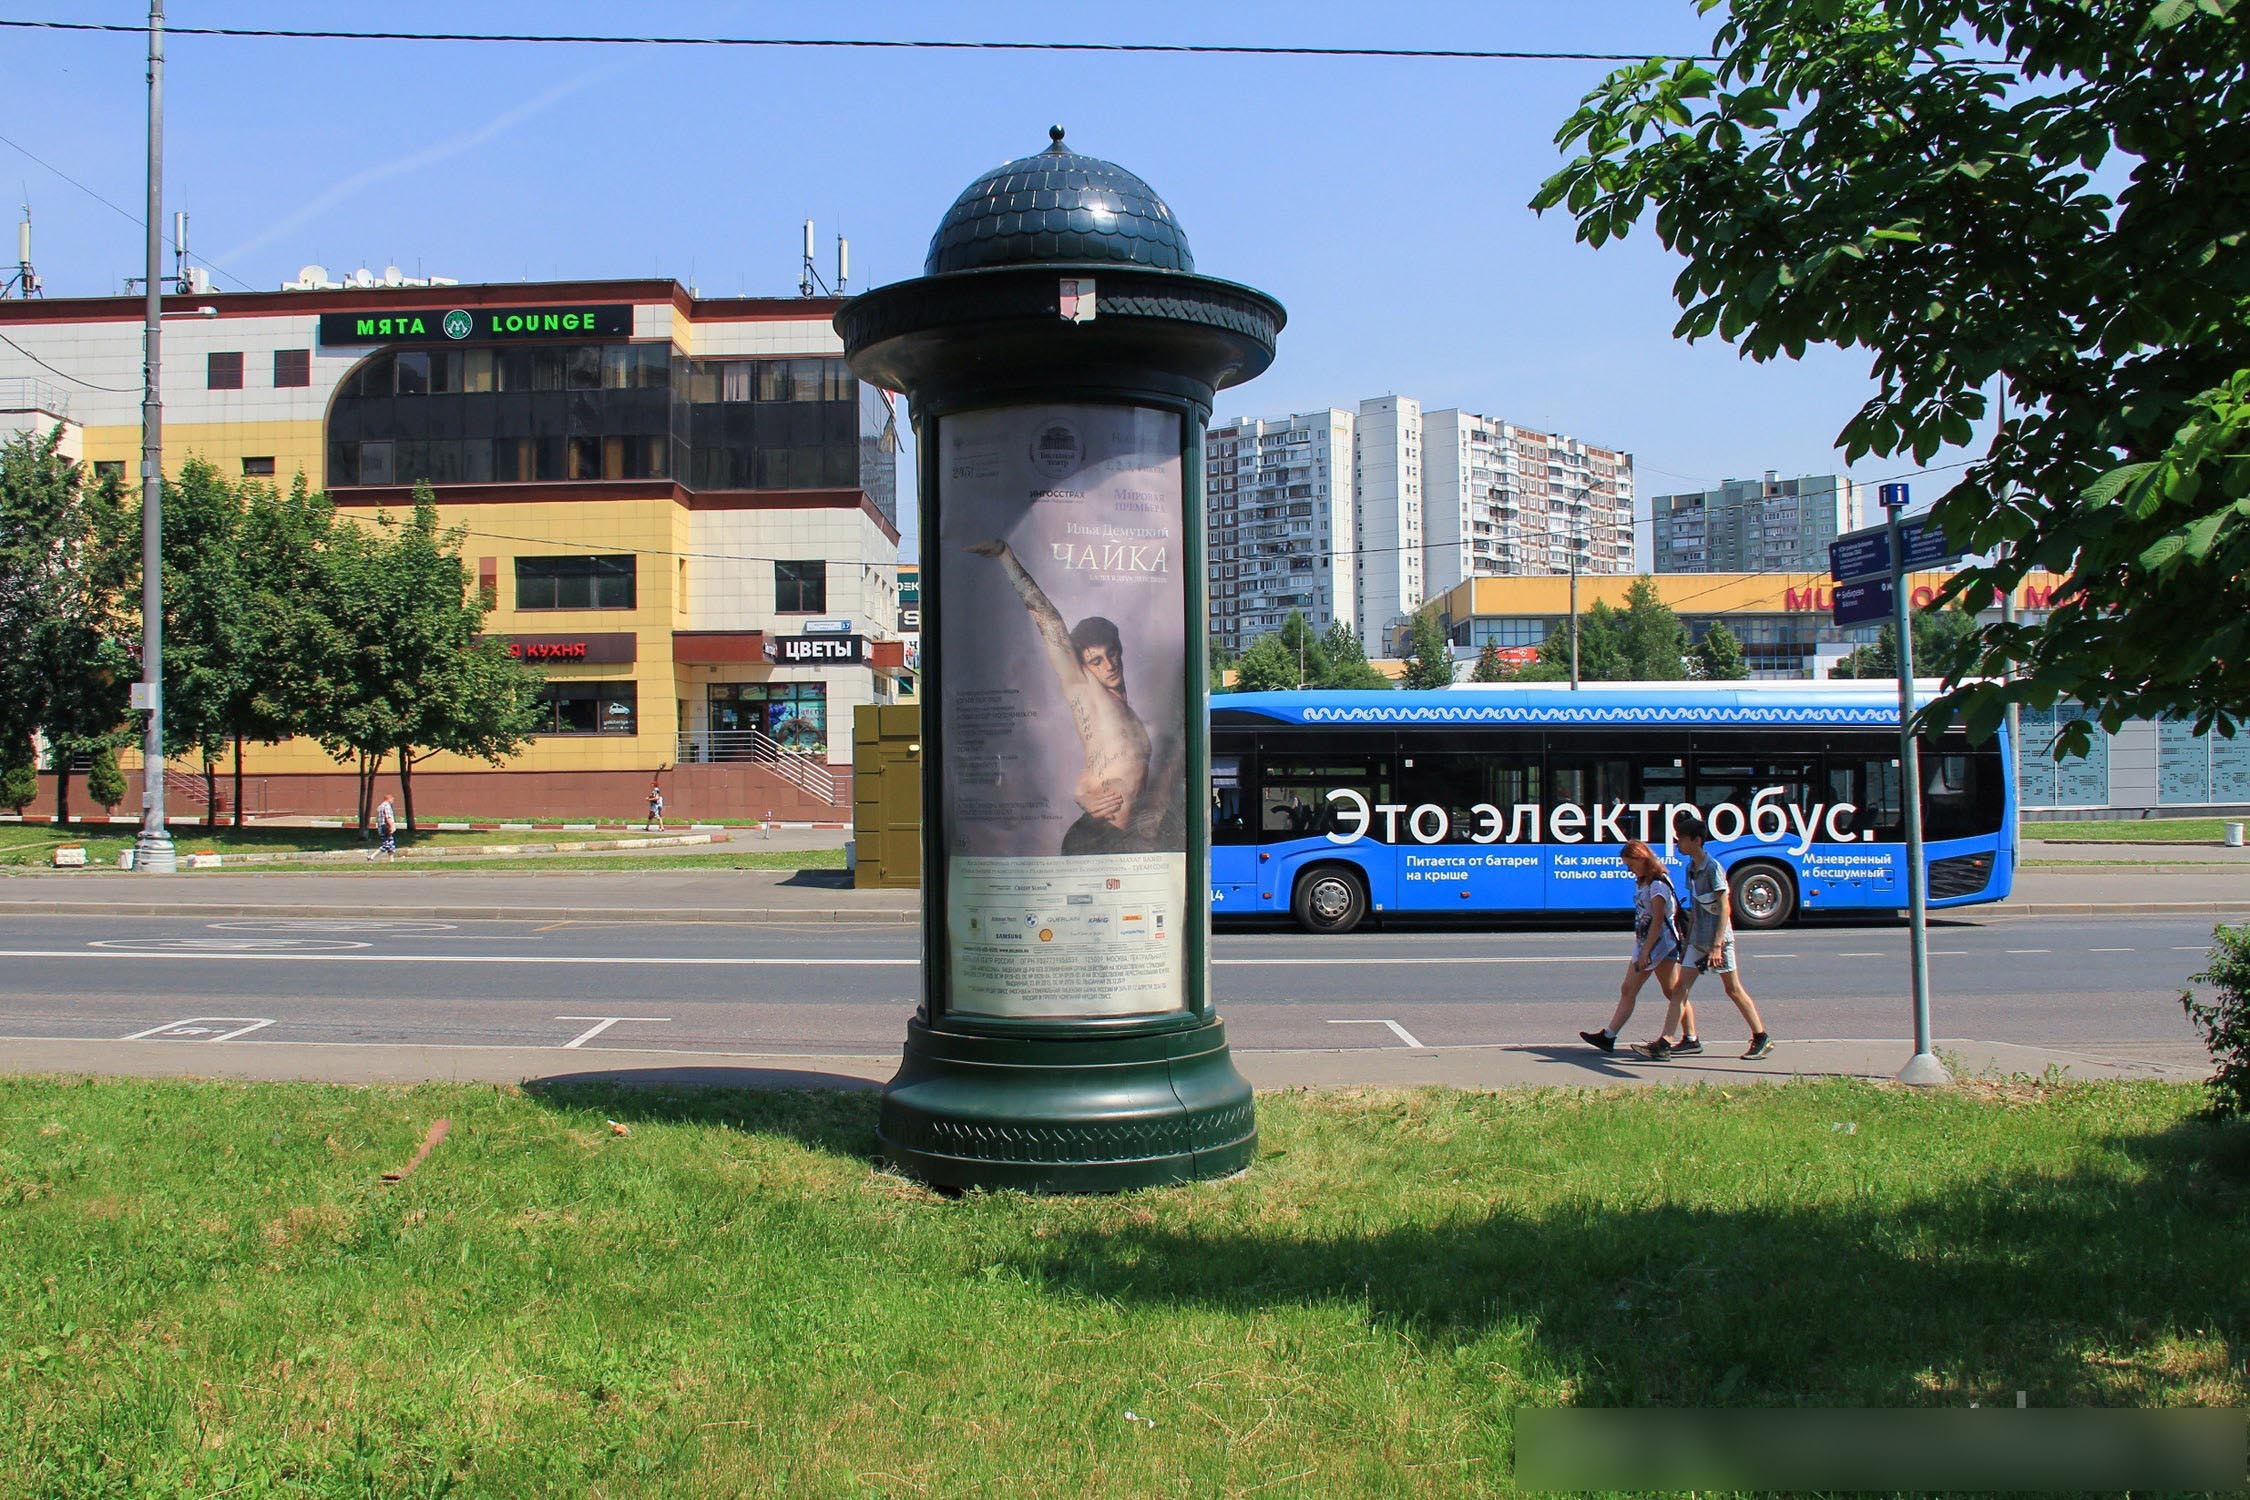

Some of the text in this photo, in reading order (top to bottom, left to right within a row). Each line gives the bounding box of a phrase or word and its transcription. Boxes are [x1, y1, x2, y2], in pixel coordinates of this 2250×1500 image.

[356, 318, 425, 335] МЯТА
[492, 313, 596, 332] LOUNGE
[1051, 539, 1169, 573] ЧАЙКА
[786, 641, 852, 660] ЦВЕТЫ
[1325, 785, 1874, 856] Это электробус.
[1406, 855, 1538, 868] Питается от батареи
[1554, 855, 1578, 866] Как
[1802, 854, 1892, 866] Маневренный
[1406, 870, 1469, 882] на крыше
[1554, 870, 1597, 880] только
[1802, 867, 1884, 880] и бесшумный
